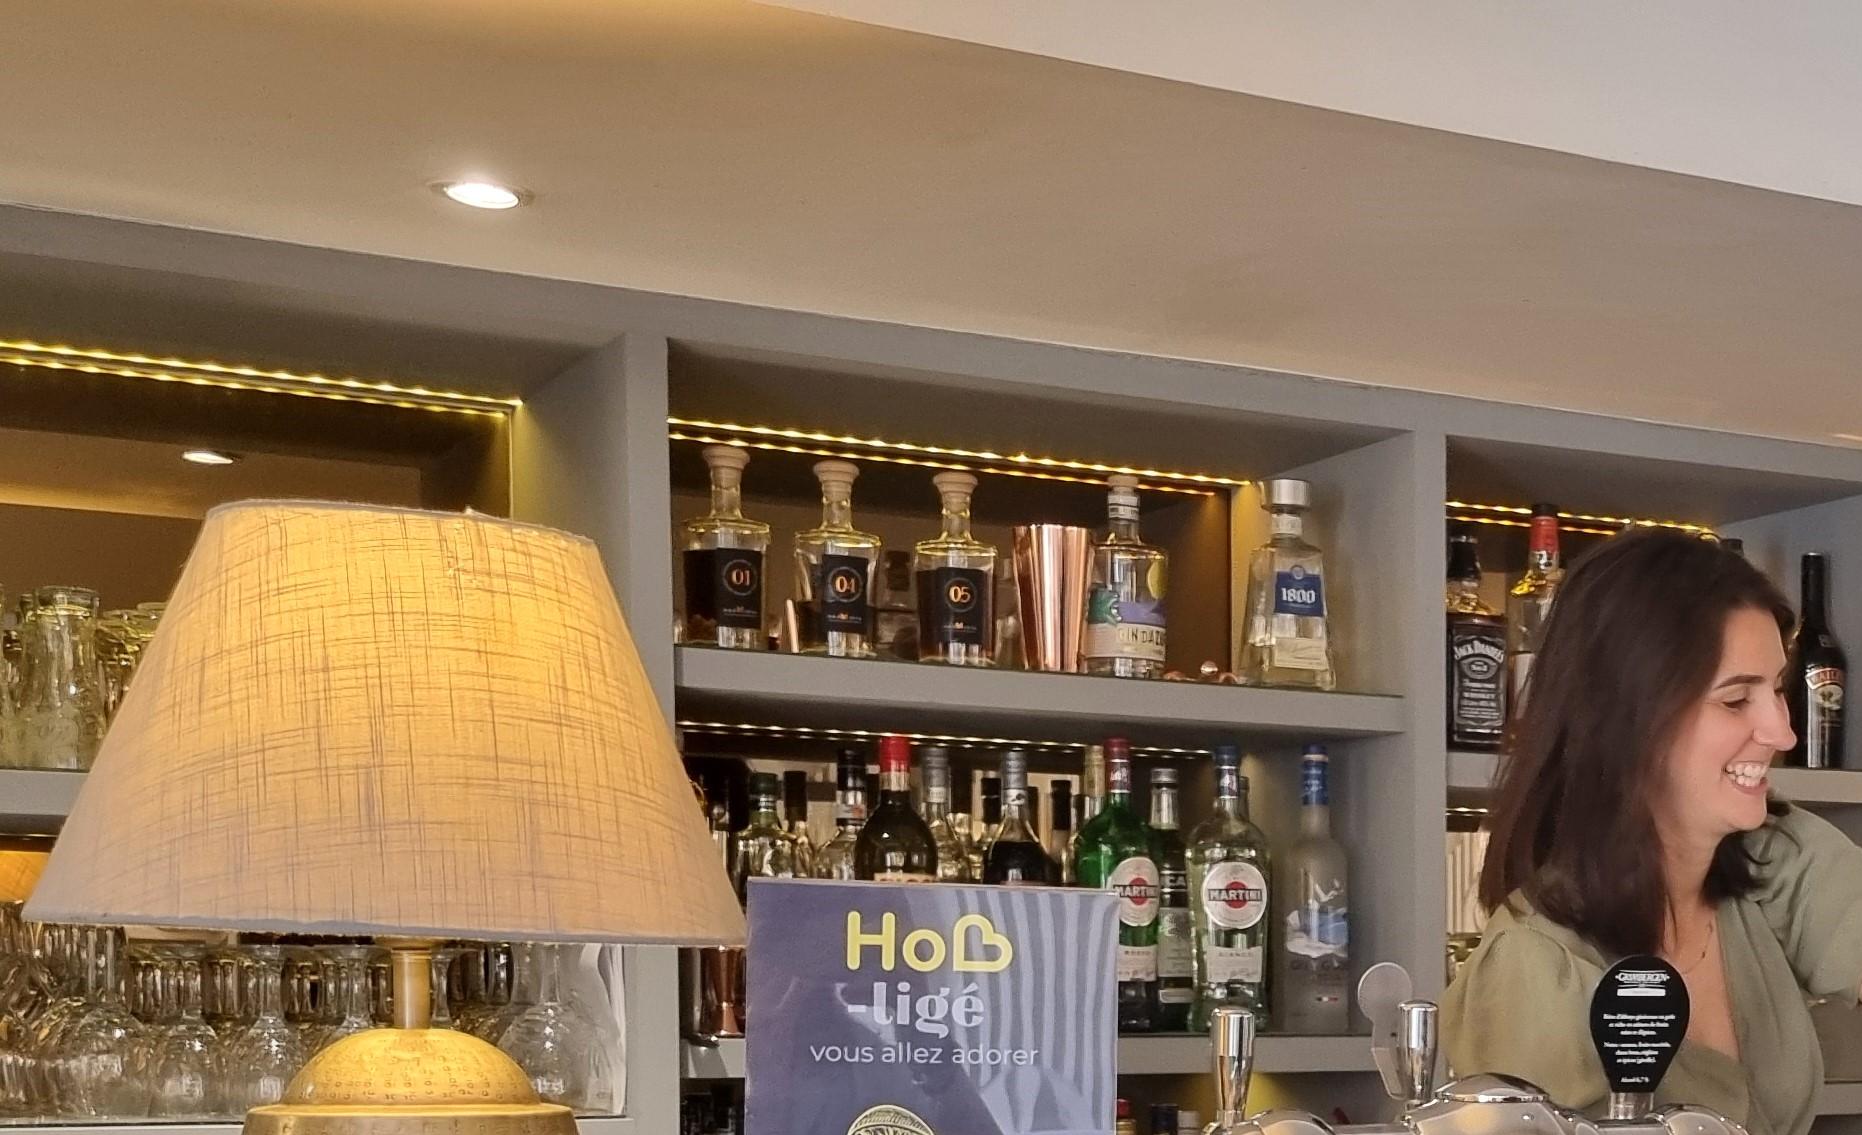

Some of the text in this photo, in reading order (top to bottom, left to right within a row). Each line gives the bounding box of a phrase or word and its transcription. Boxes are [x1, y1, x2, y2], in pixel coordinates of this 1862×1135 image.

[950, 585, 972, 603] 05
[1281, 587, 1316, 604] 1800
[1209, 888, 1262, 902] MARTINI
[809, 1042, 1038, 1066] vous allez adorer
